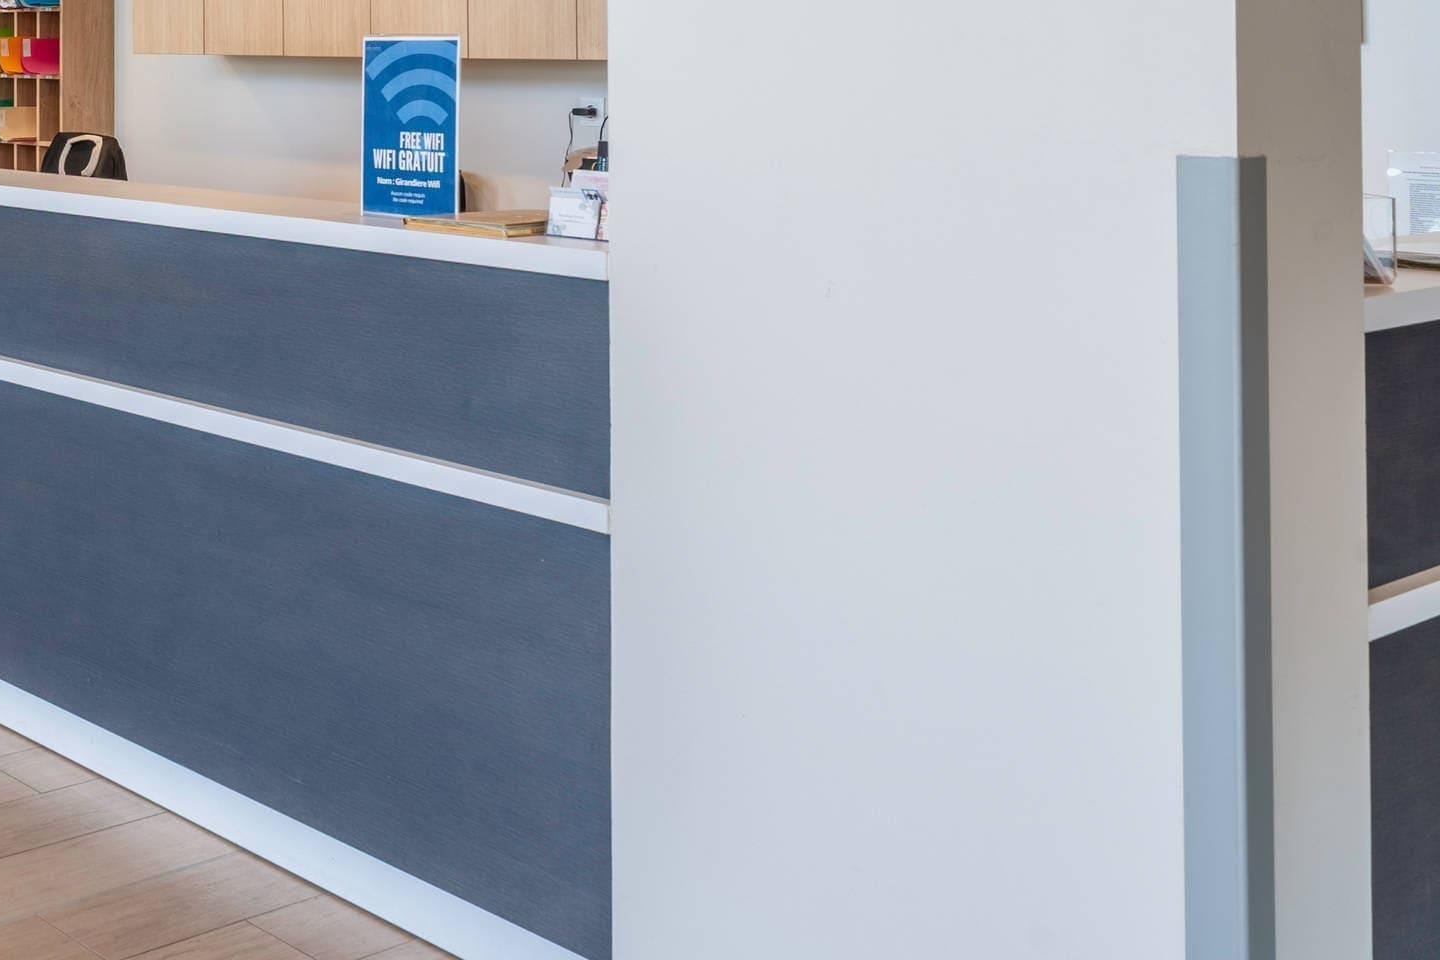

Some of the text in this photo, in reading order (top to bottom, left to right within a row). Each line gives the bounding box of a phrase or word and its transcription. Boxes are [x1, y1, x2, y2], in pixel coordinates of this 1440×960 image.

[400, 131, 444, 151] FREE WIFI
[372, 148, 445, 173] WIFI GRATUIT
